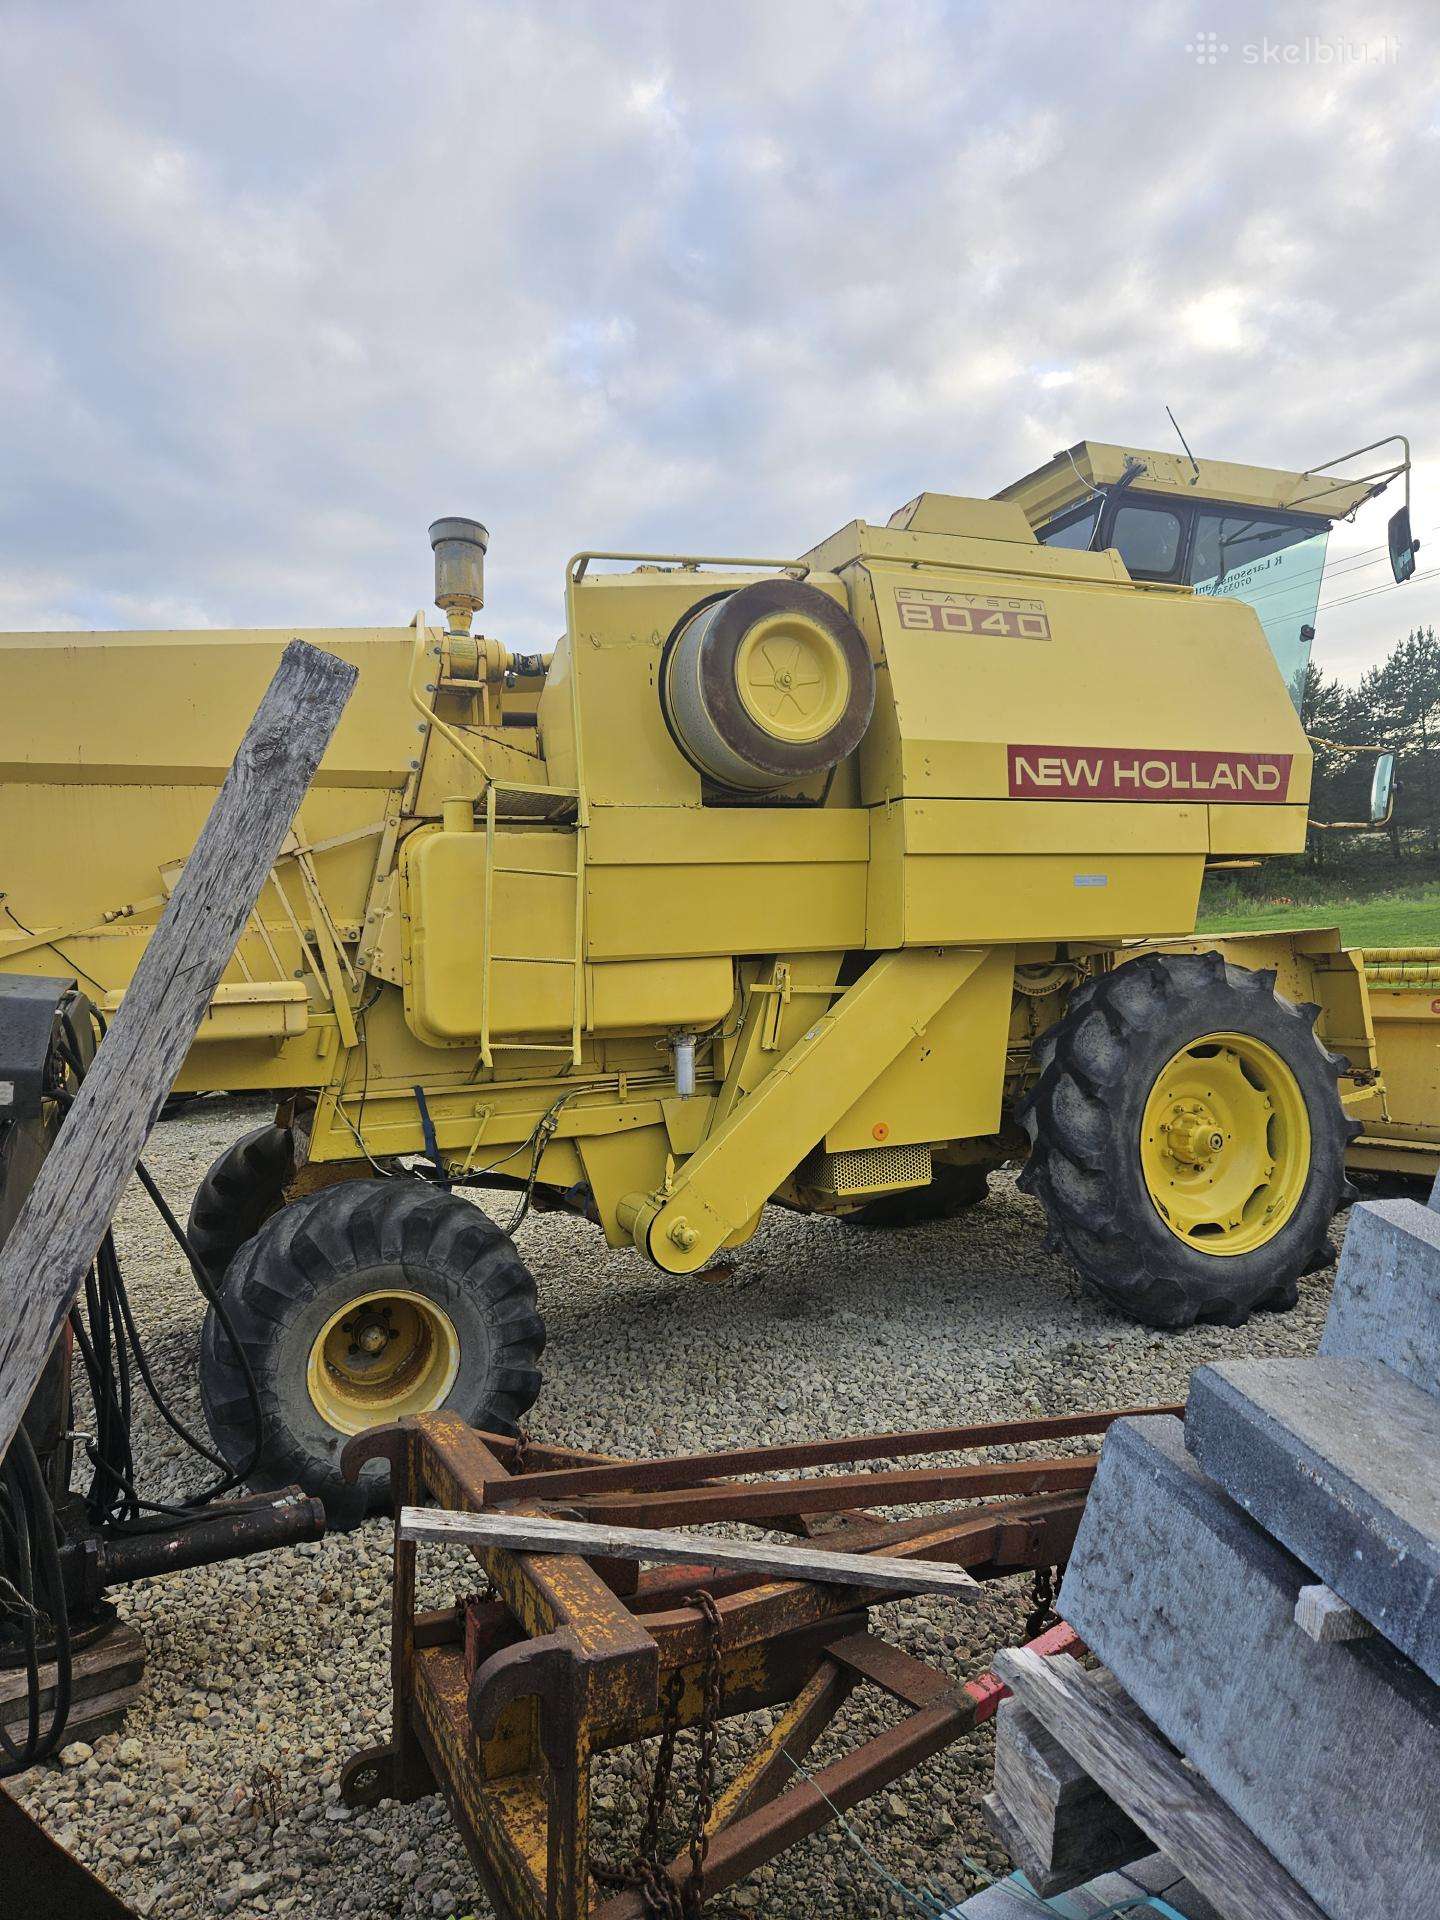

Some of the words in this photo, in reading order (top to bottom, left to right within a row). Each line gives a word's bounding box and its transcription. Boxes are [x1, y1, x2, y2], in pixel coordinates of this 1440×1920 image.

[898, 590, 1044, 611] CLAYSON
[901, 603, 1048, 638] 8040
[1015, 757, 1103, 787] NEW
[1113, 760, 1281, 791] HOLLAND
